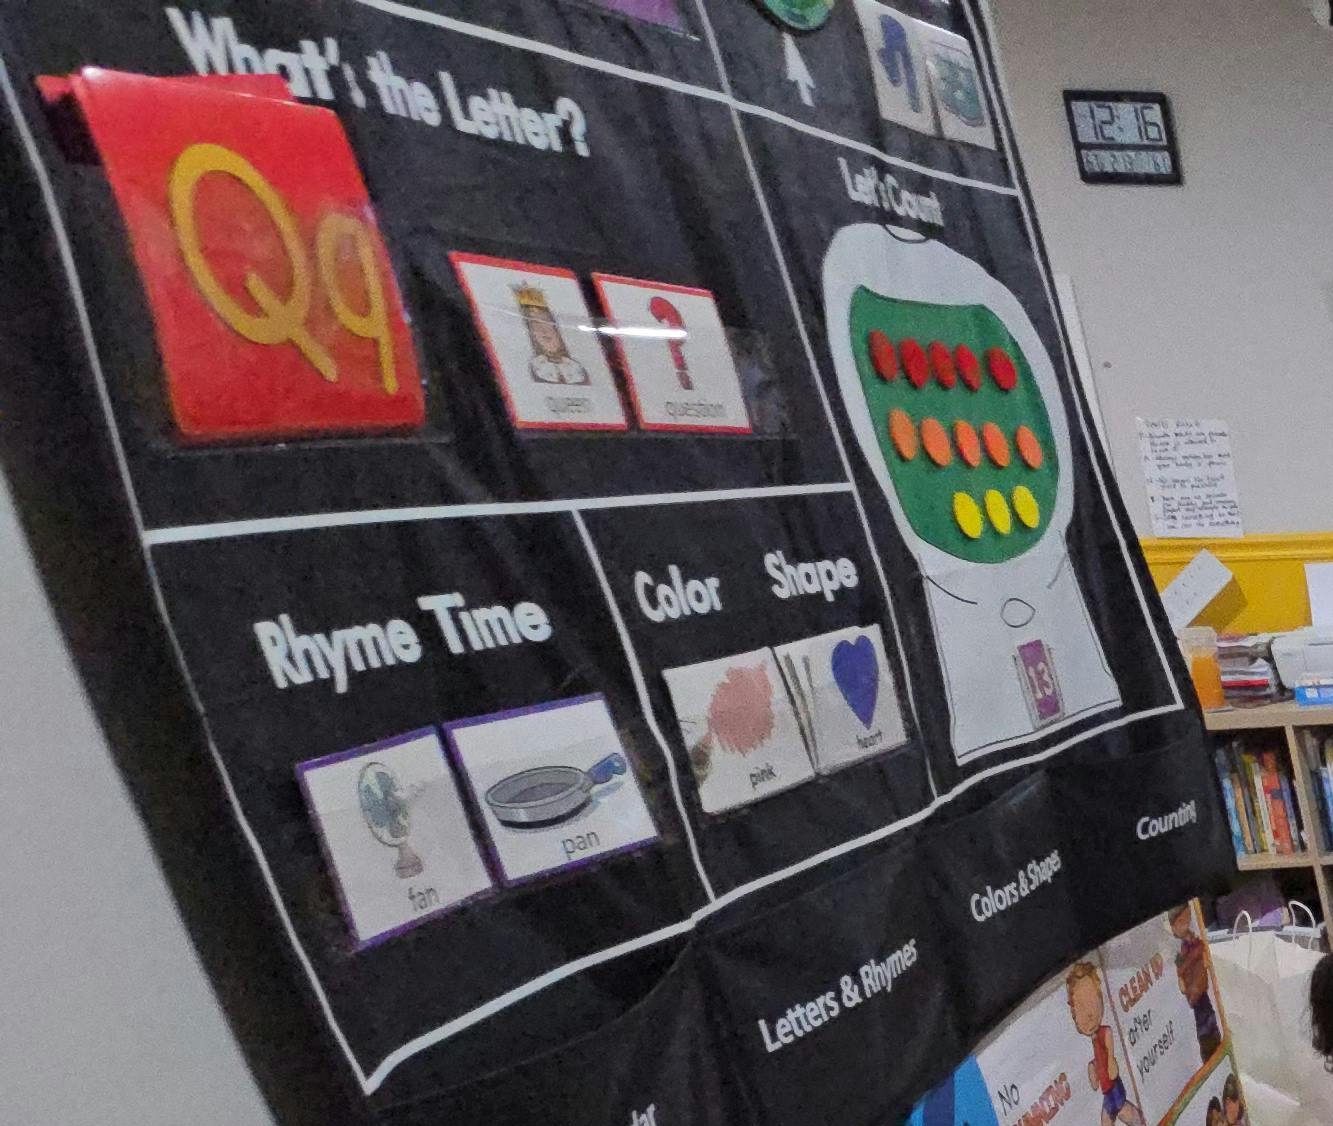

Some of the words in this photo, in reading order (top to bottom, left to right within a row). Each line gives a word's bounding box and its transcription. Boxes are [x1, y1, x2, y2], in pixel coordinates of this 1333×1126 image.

[367, 51, 442, 127] the
[438, 70, 591, 157] Letter?
[1088, 103, 1163, 142] 12:16
[168, 143, 398, 395] Qq
[634, 565, 723, 623] Color
[763, 550, 859, 602] Shape
[254, 614, 422, 694] Rhyme
[417, 593, 554, 656] Time
[1135, 800, 1198, 841] Counting
[562, 831, 602, 862] pan
[407, 884, 441, 912] fan
[970, 881, 1018, 923] Colors
[758, 991, 838, 1053] Letters
[840, 972, 863, 1010] &
[860, 937, 919, 998] Rhymes
[1128, 1008, 1152, 1046] after
[1136, 1020, 1175, 1082] yourself
[997, 1082, 1020, 1117] No
